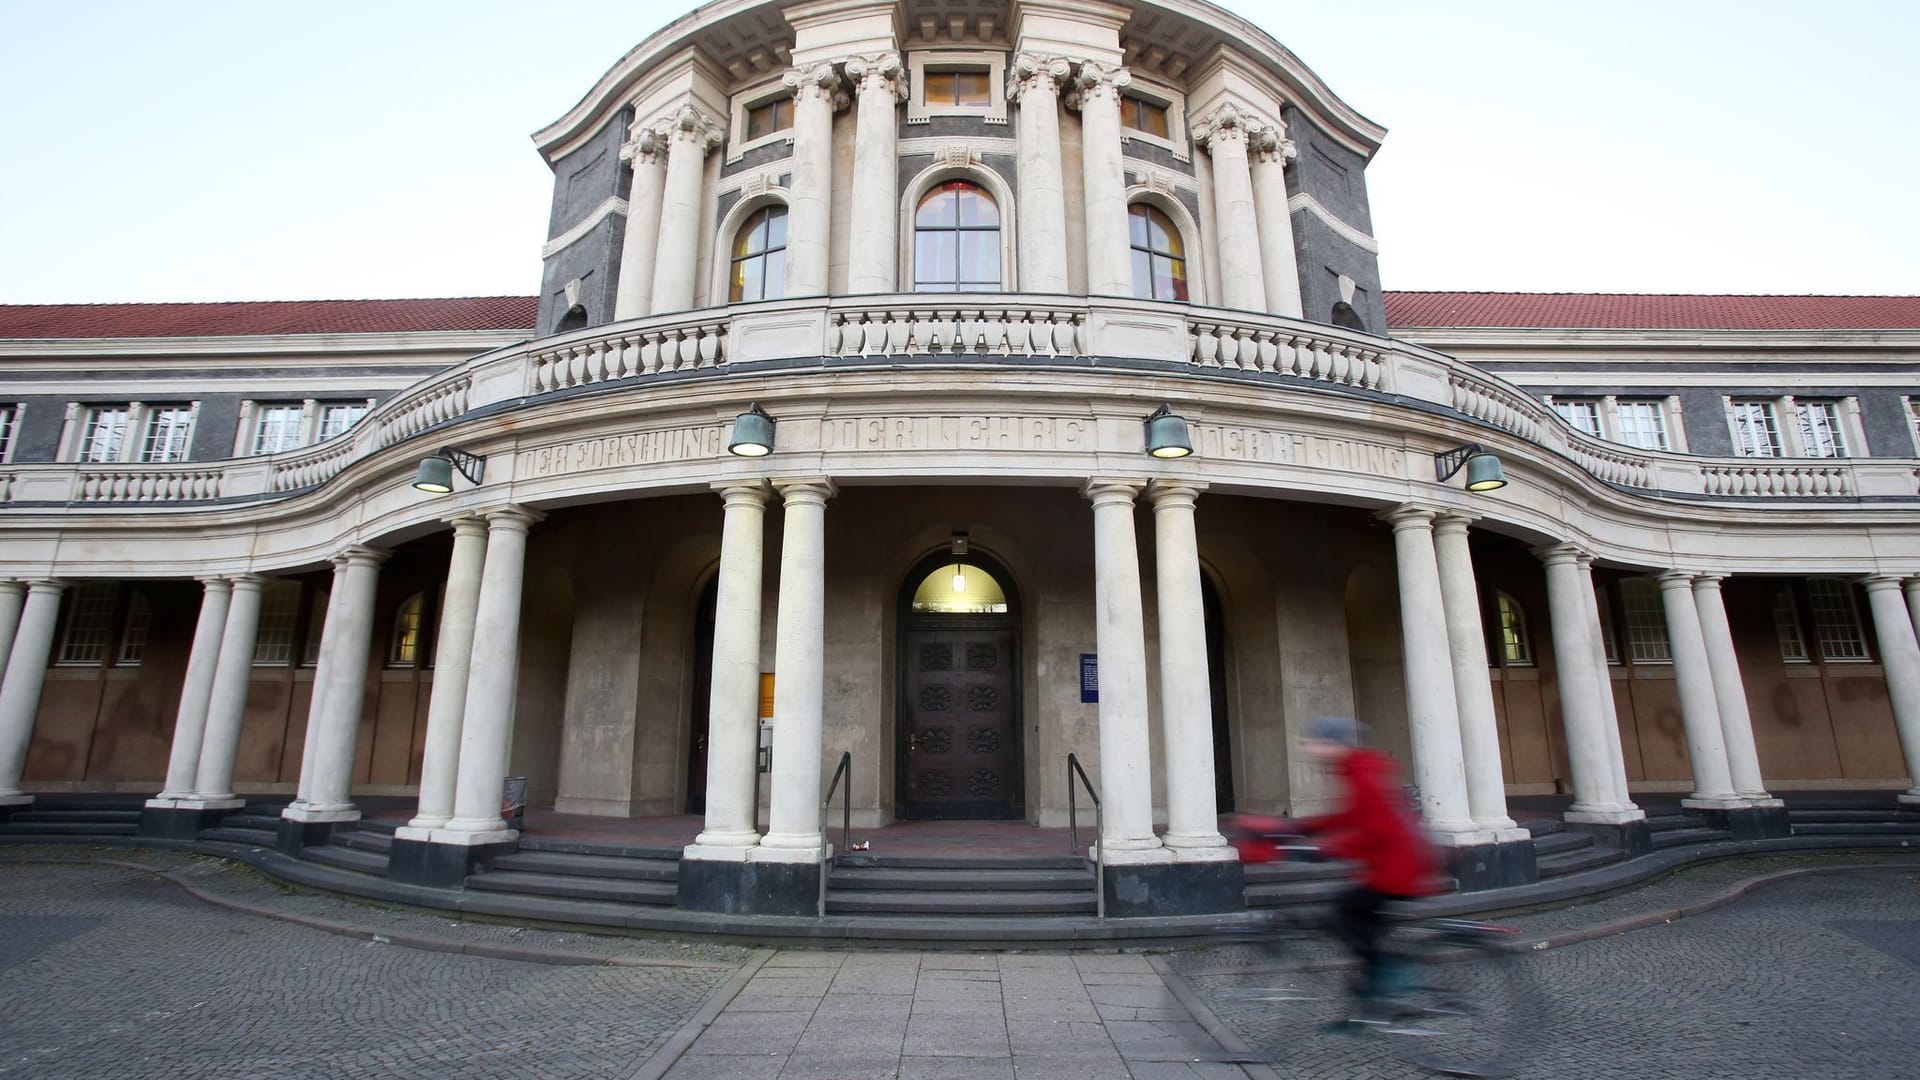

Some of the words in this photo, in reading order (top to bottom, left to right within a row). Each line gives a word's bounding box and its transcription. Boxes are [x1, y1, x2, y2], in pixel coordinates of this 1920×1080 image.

[822, 418, 914, 449] DER
[927, 418, 1088, 449] LEHRE
[1193, 426, 1264, 460] DER
[518, 444, 568, 478] DER
[571, 427, 721, 471] FORSCHUNG
